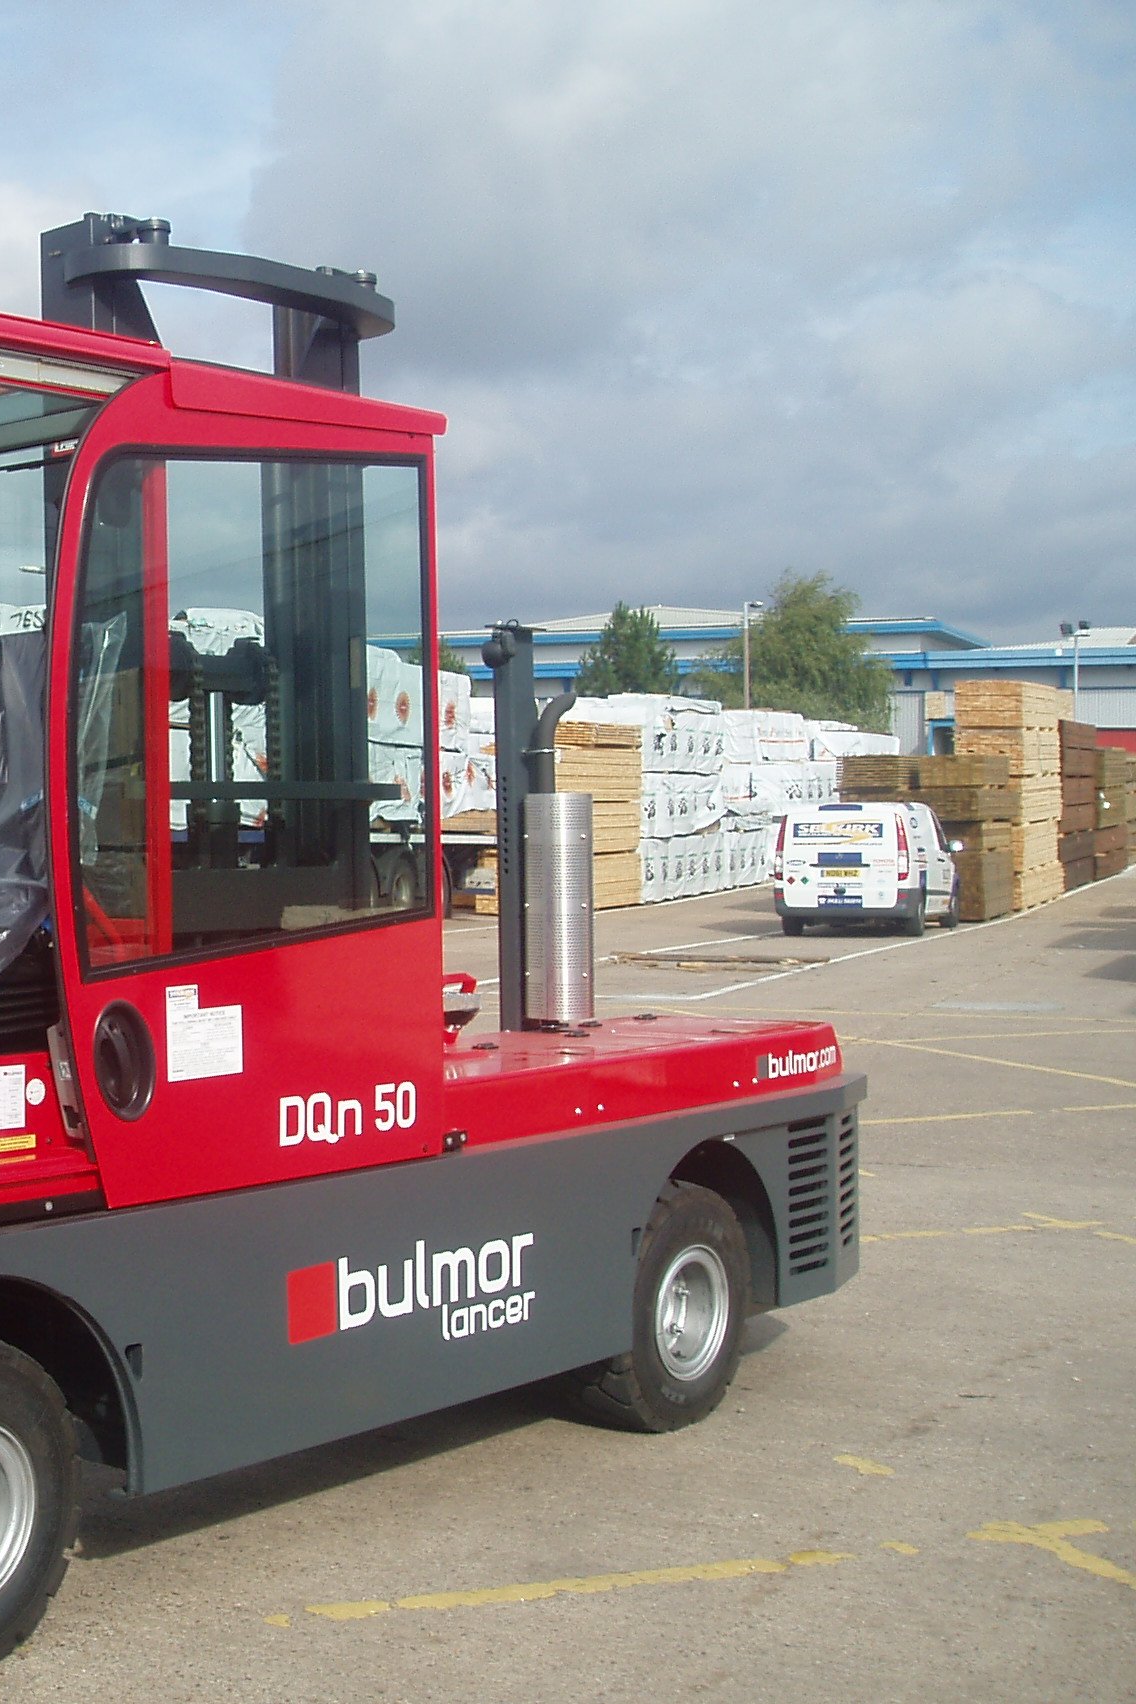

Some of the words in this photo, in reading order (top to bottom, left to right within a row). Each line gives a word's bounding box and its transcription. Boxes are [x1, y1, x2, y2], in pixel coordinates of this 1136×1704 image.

[768, 1045, 837, 1079] bulmor.com
[279, 1091, 363, 1147] DQn
[374, 1081, 416, 1132] 50
[338, 1232, 534, 1331] bulmor
[441, 1291, 536, 1340] lancer
